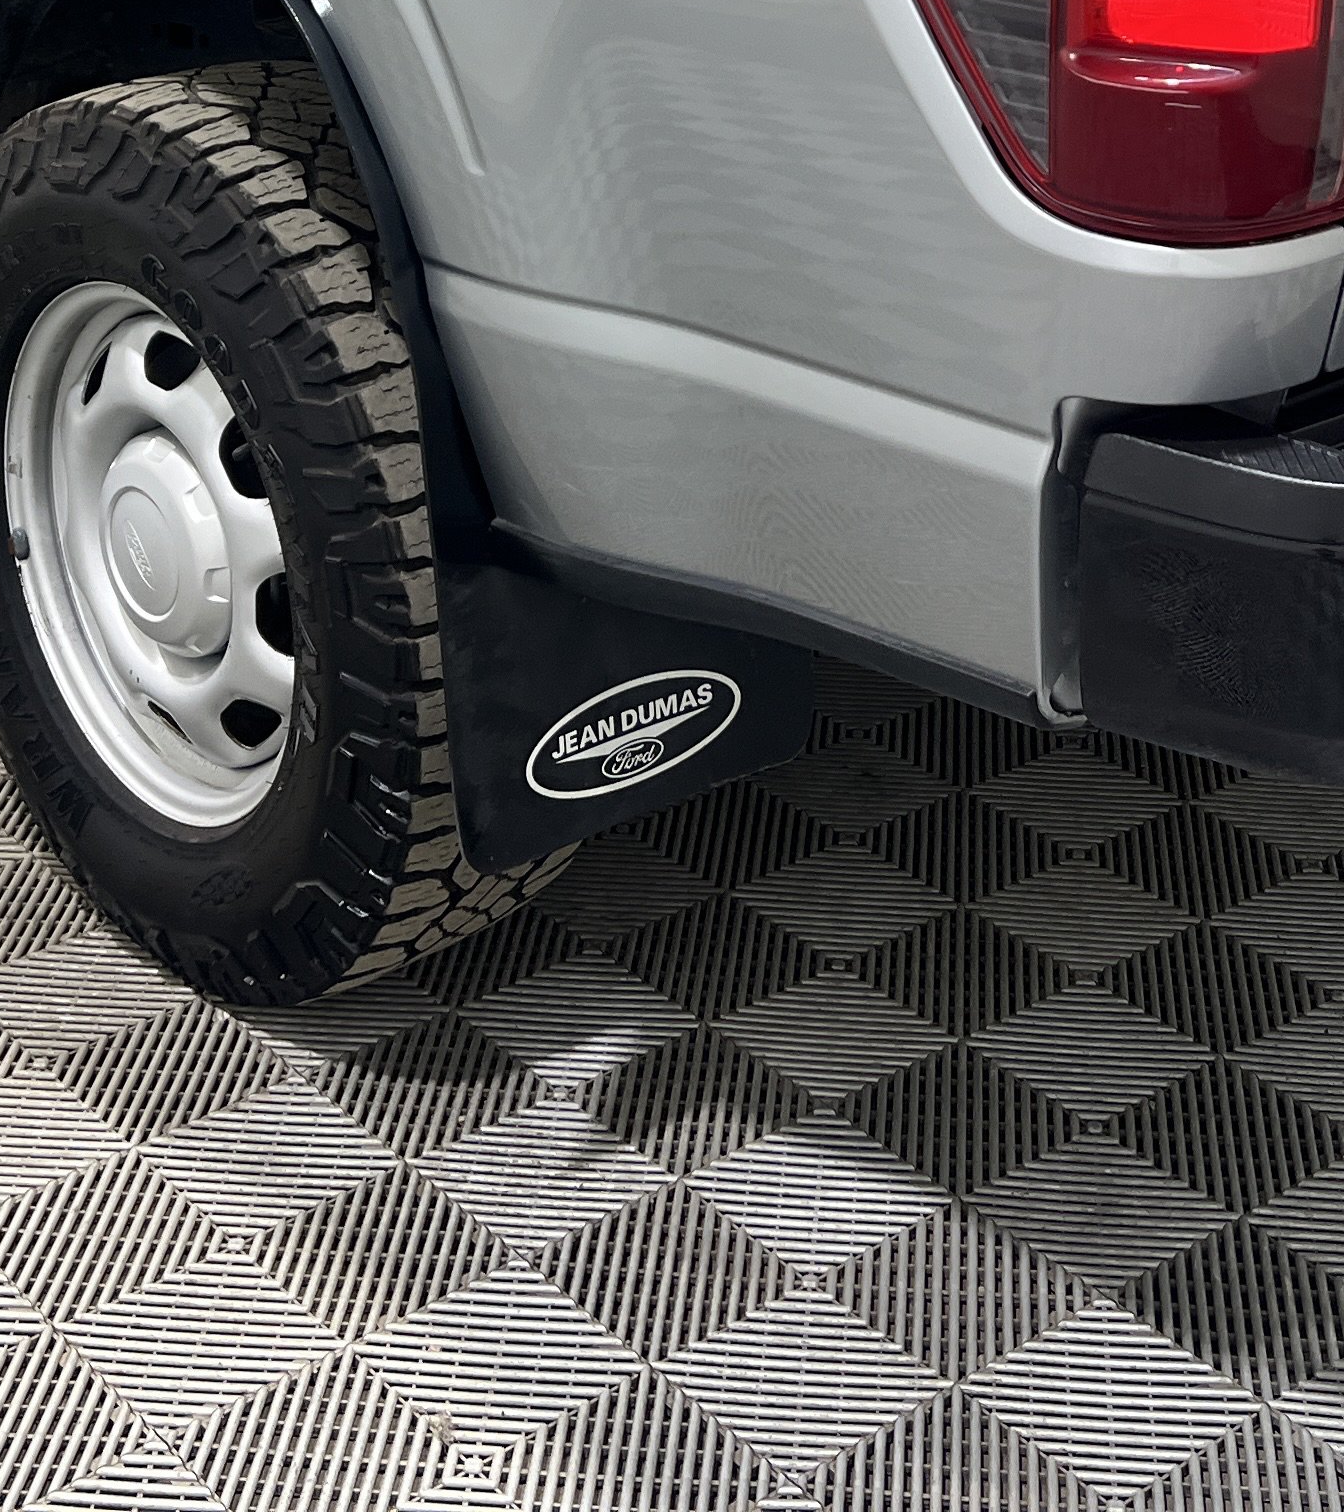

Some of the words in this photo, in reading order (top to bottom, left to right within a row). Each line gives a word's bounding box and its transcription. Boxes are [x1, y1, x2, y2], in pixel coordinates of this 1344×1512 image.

[551, 715, 615, 760] JEAN
[620, 682, 714, 734] DUMAS
[611, 743, 655, 774] Ford
